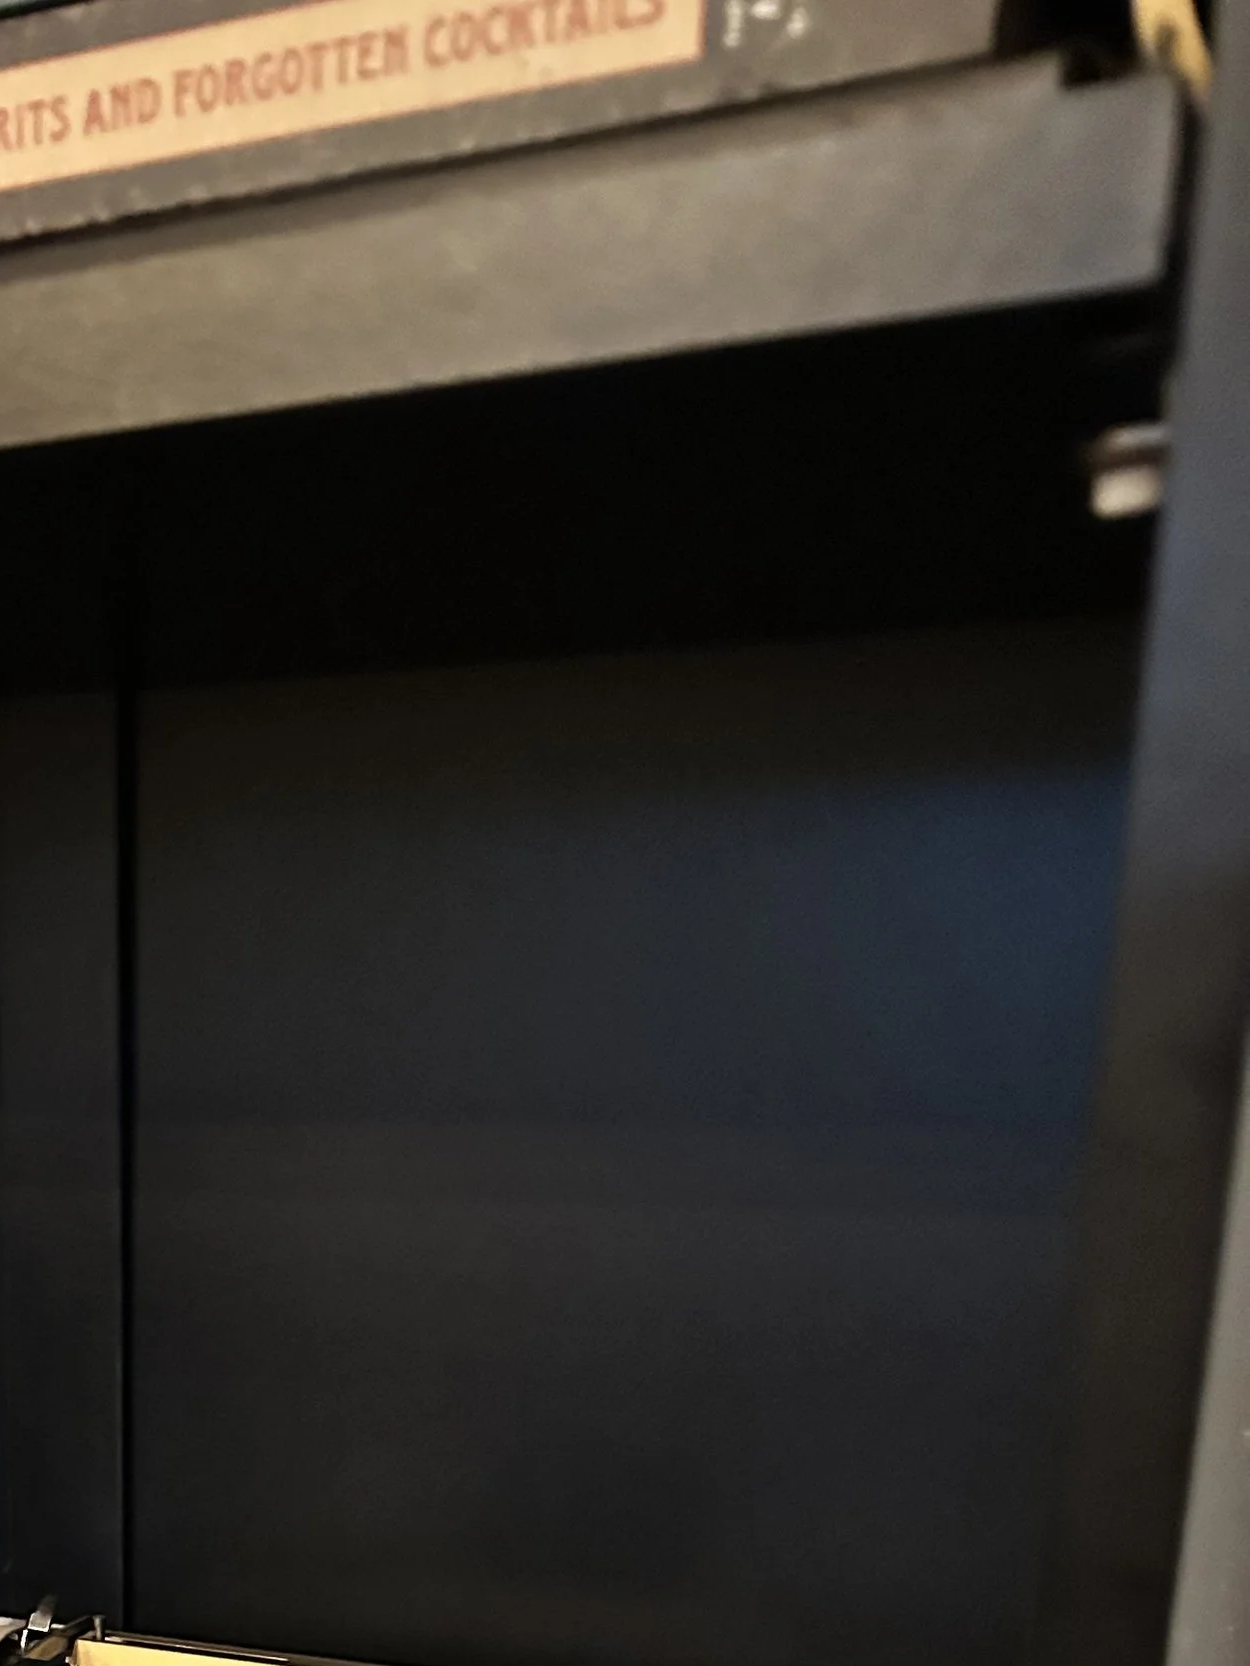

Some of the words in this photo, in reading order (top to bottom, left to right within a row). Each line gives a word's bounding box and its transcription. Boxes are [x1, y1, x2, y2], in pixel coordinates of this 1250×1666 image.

[81, 76, 164, 138] AND
[172, 32, 410, 119] FORGOTTEN
[422, 0, 669, 69] COCKTAILS
